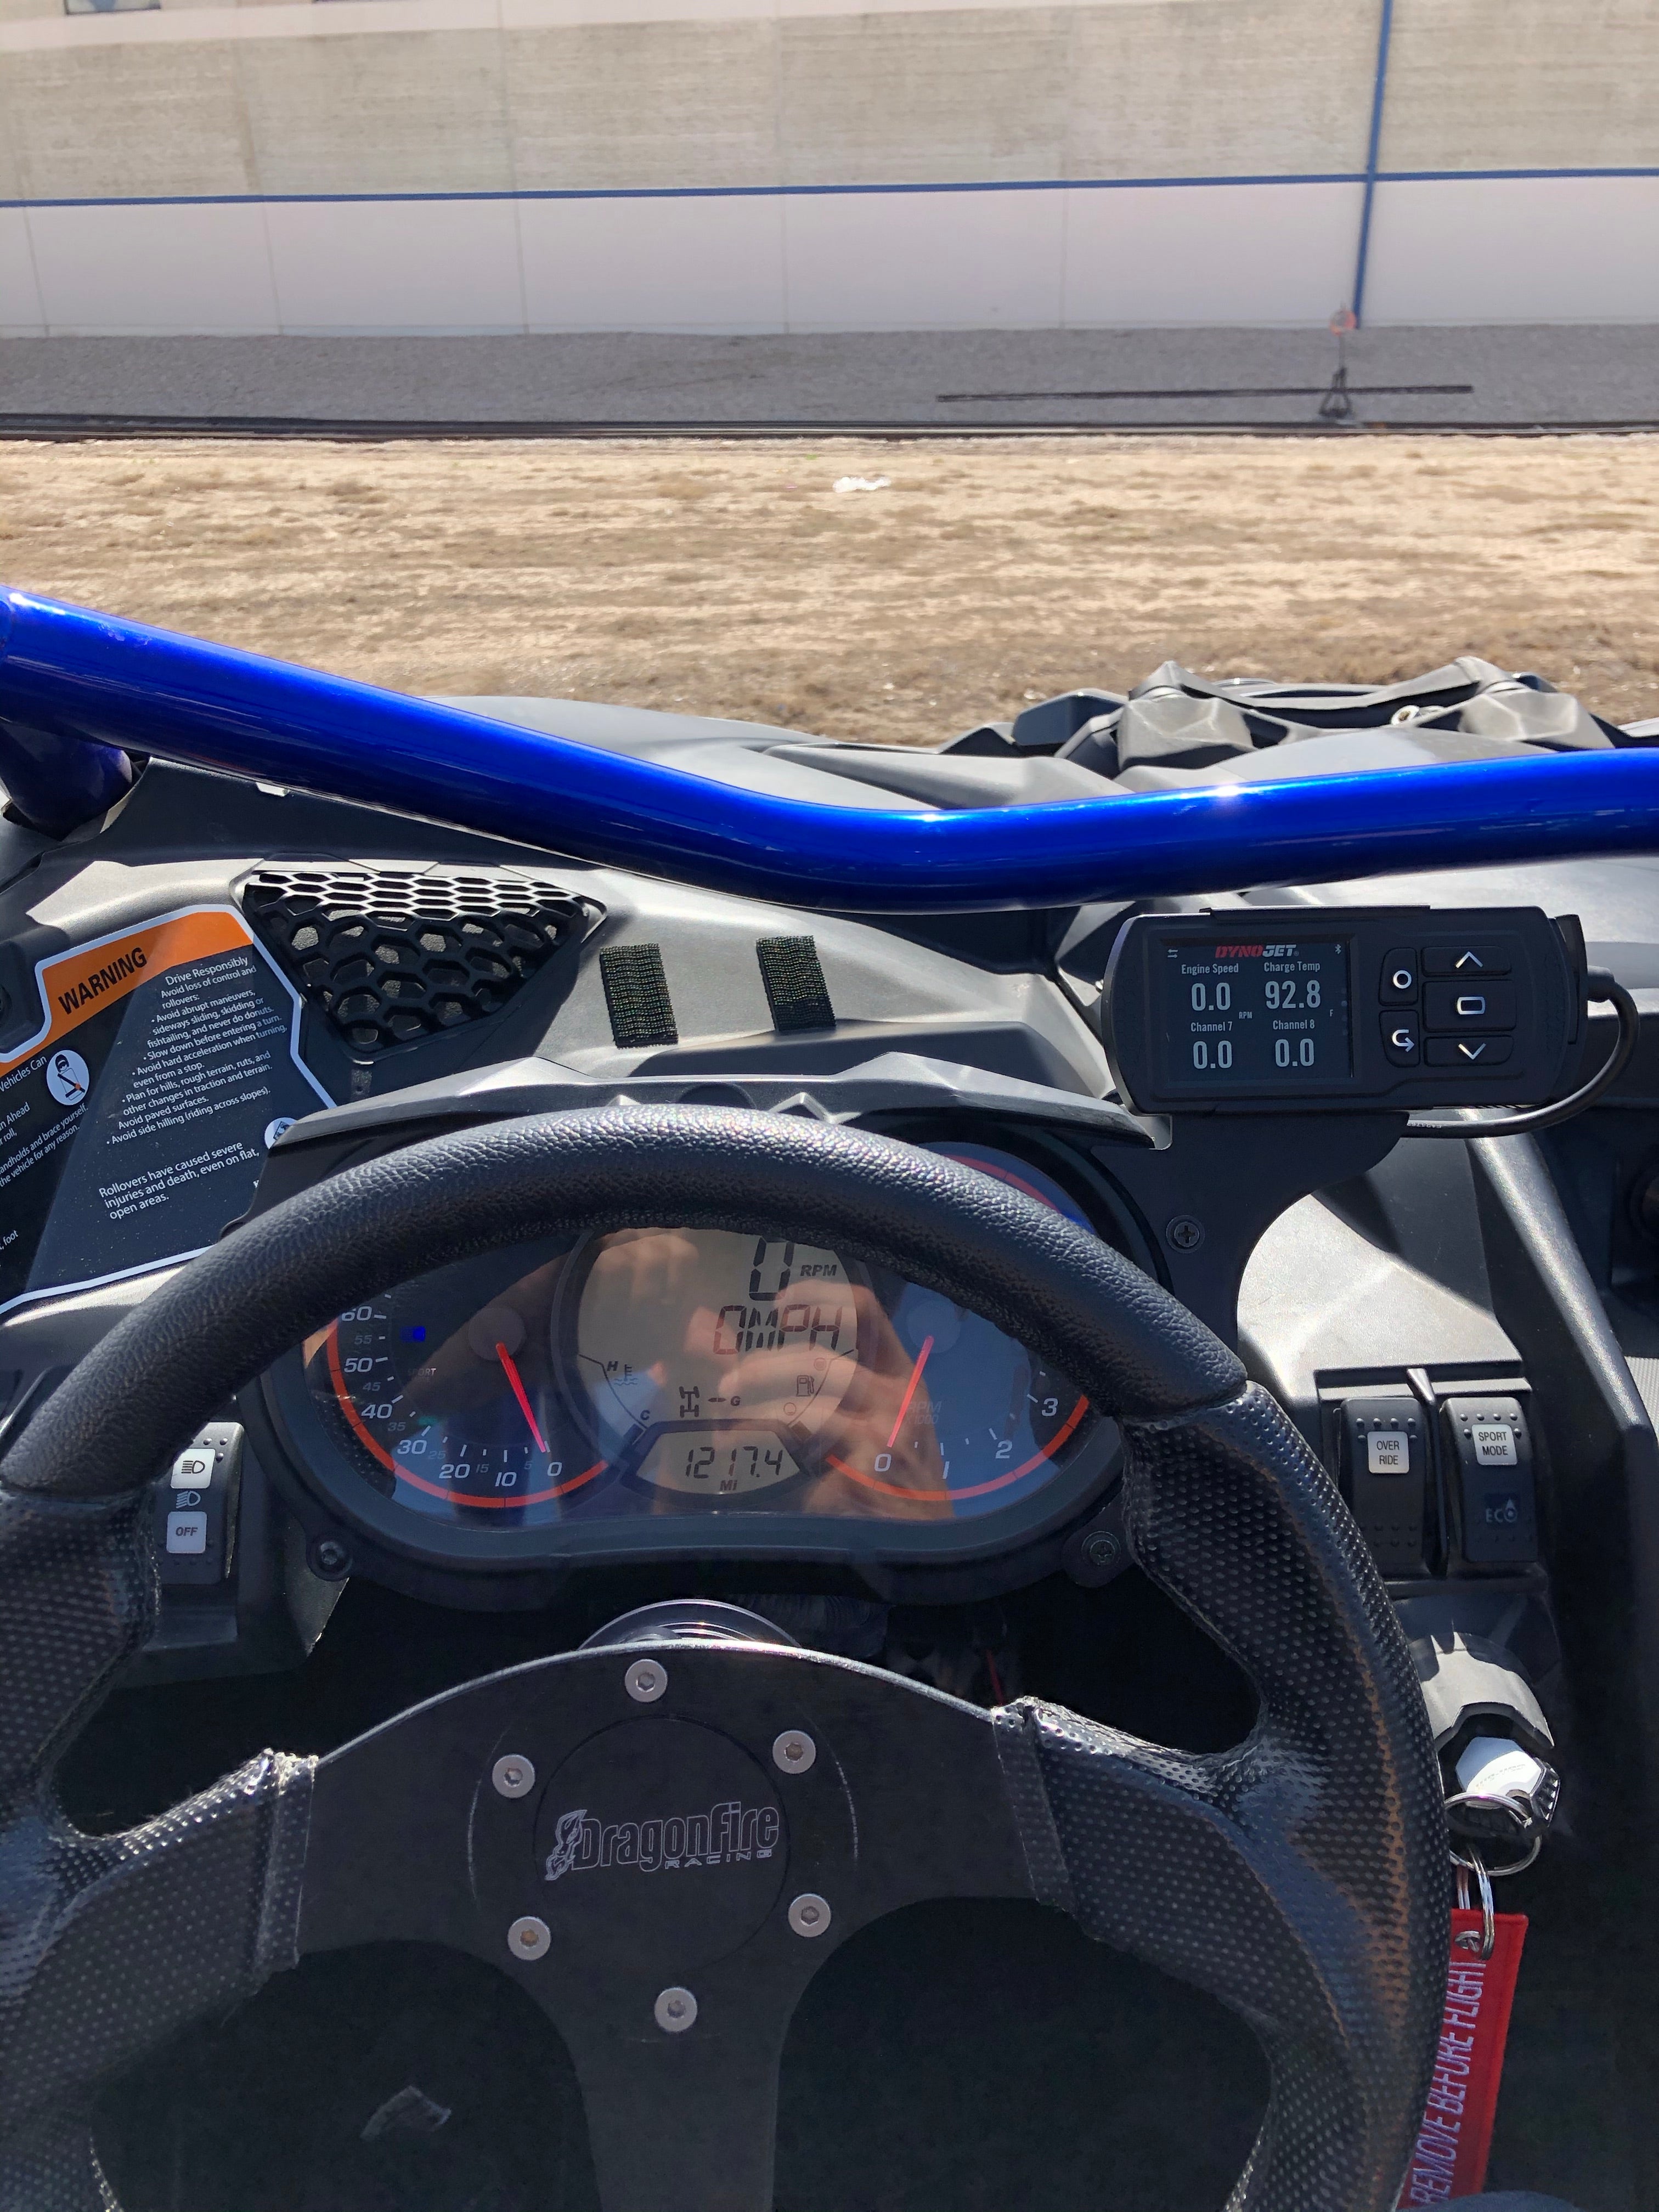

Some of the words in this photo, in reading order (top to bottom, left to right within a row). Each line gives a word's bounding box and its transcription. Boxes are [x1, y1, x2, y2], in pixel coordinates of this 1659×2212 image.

[165, 972, 192, 985] Drive
[192, 957, 249, 978] Responsibly
[1181, 964, 1210, 975] Engine
[1212, 963, 1239, 975] Speed
[1264, 962, 1295, 973] Charge
[1297, 961, 1321, 973] Temp
[58, 947, 148, 1014] WARNING
[161, 986, 185, 998] Avoid
[186, 983, 202, 992] loss
[202, 977, 212, 987] of
[212, 970, 241, 984] control
[241, 965, 257, 977] and
[162, 993, 200, 1009] rollovers:
[1192, 983, 1231, 1011] 0.0
[1265, 980, 1321, 1009] 92.8
[156, 1010, 180, 1023] Avoid
[182, 1002, 210, 1015] abrupt
[210, 989, 256, 1007] maneuvers,
[147, 1031, 191, 1048] fishtailing,
[192, 1024, 208, 1036] and
[208, 1019, 232, 1030] never
[233, 1014, 244, 1023] do
[245, 1006, 274, 1019] donuts.
[153, 1020, 190, 1035] sideways
[192, 1009, 221, 1024] sliding,
[221, 1000, 255, 1015] skidding
[1190, 1022, 1225, 1032] Channel
[1227, 1022, 1233, 1031] 7
[1273, 1020, 1308, 1030] Channel
[1310, 1019, 1315, 1029] 8
[148, 1049, 168, 1060] Slow
[170, 1041, 194, 1054] down
[194, 1033, 221, 1046] before
[222, 1022, 256, 1038] entering
[263, 1014, 282, 1025] turn.
[137, 1064, 162, 1076] Avoid
[162, 1056, 183, 1068] hard
[183, 1042, 233, 1062] acceleration
[233, 1034, 256, 1046] when
[256, 1024, 287, 1039] turning,
[1193, 1041, 1232, 1069] 0.0
[1275, 1038, 1314, 1067] 0.0
[30, 1056, 47, 1068] Can
[126, 1091, 146, 1103] Plan
[146, 1086, 159, 1097] for
[159, 1081, 180, 1092] hills,
[180, 1071, 206, 1086] rough
[206, 1064, 236, 1078] terrain,
[236, 1058, 255, 1069] ruts,
[256, 1051, 271, 1062] and
[133, 1077, 154, 1088] even
[155, 1071, 177, 1083] from
[184, 1061, 205, 1074] stop.
[123, 1103, 146, 1116] other
[148, 1092, 184, 1109] changes
[184, 1087, 194, 1097] in
[194, 1078, 227, 1093] traction
[228, 1071, 244, 1083] and
[244, 1063, 273, 1077] terrain.
[7, 1102, 30, 1125] Ahead
[111, 1129, 137, 1144] Avoid
[138, 1123, 156, 1136] side
[156, 1114, 185, 1130] hilling
[185, 1104, 213, 1121] (riding
[214, 1097, 240, 1111] across
[241, 1086, 271, 1103] slopes).
[118, 1114, 144, 1130] Avoid
[144, 1107, 172, 1122] paved
[172, 1096, 210, 1112] surfaces.
[0, 1147, 30, 1174] andholds
[30, 1136, 43, 1151] and
[42, 1124, 61, 1141] brace
[60, 1103, 88, 1130] yourself.
[3, 1128, 18, 1142] roll,
[0, 1175, 11, 1187] the
[11, 1157, 35, 1177] vehicle
[33, 1150, 44, 1161] for
[44, 1140, 57, 1153] any
[56, 1124, 80, 1144] reason.
[98, 1175, 148, 1198] Rollovers
[148, 1165, 174, 1181] have
[175, 1153, 211, 1172] caused
[211, 1142, 244, 1159] severe
[104, 1189, 144, 1209] injuries
[145, 1182, 166, 1195] and
[167, 1169, 200, 1187] death,
[200, 1160, 225, 1175] even
[225, 1155, 240, 1165] on
[240, 1147, 259, 1161] flat,
[110, 1204, 138, 1220] open
[139, 1193, 170, 1209] areas.
[3, 1230, 19, 1246] foot
[800, 1265, 837, 1277] RPM
[341, 1306, 372, 1322] 60
[354, 1335, 372, 1344] 55
[344, 1357, 373, 1373] 50
[607, 1361, 618, 1371] H
[362, 1382, 381, 1391] 45
[361, 1404, 393, 1419] 40
[640, 1410, 650, 1420] C
[1042, 1398, 1058, 1417] 3
[387, 1422, 406, 1431] 35
[1376, 1441, 1400, 1451] OVER
[1478, 1431, 1508, 1442] SPORT
[397, 1440, 427, 1454] 30
[428, 1451, 446, 1460] 25
[995, 1440, 1012, 1459] 2
[1482, 1446, 1508, 1456] MODE
[476, 1464, 489, 1473] 15
[524, 1461, 533, 1470] 5
[547, 1462, 562, 1476] 0
[685, 1446, 783, 1479] 1217.4
[874, 1453, 891, 1472] 0
[1379, 1455, 1398, 1465] RIDE
[439, 1463, 470, 1479] 20
[495, 1471, 517, 1487] 10
[943, 1462, 950, 1480] 1
[1486, 1499, 1518, 1523] ECO
[175, 1526, 198, 1537] OFF
[665, 1849, 772, 1870] RACING
[1443, 1961, 1486, 2029] FLIGHT
[1427, 2032, 1474, 2115] BEFORE
[1410, 2112, 1460, 2204] REMOVE
